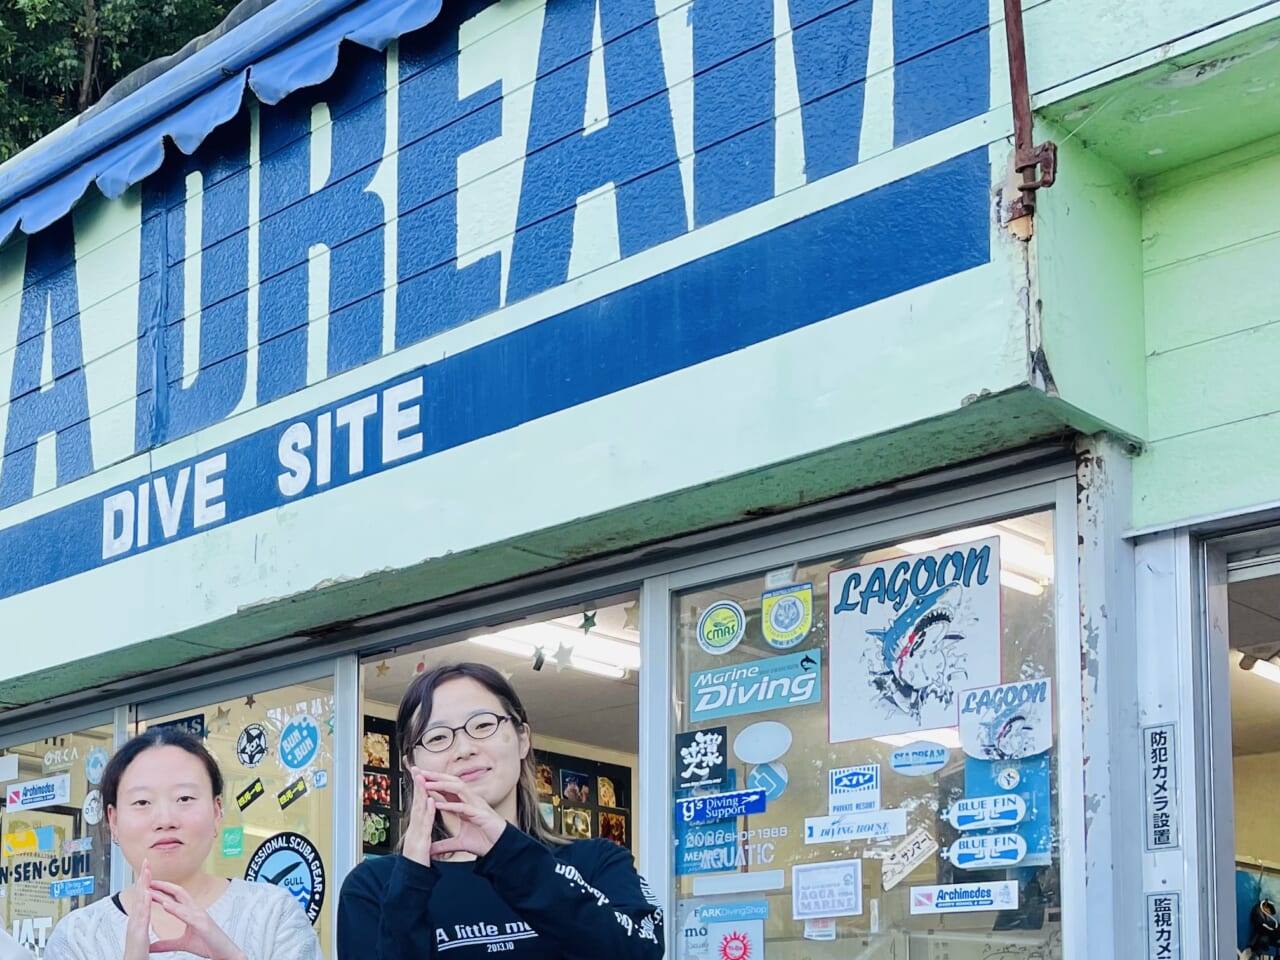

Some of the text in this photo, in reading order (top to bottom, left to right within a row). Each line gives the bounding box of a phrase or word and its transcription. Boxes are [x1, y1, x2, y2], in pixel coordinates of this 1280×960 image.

[102, 376, 424, 560] DIVE SITE
[834, 545, 991, 613] LAGOON
[694, 666, 760, 688] Marine
[694, 673, 817, 713] Diving
[962, 681, 1047, 714] LAGOON
[1150, 730, 1171, 846] 防犯カメラ設置
[705, 806, 746, 818] Support
[706, 797, 739, 809] Diving
[958, 797, 1017, 812] BLUE FIN
[958, 836, 1018, 850] BLUE FIN
[289, 836, 314, 863] SCUBA
[311, 860, 322, 893] GEAR
[284, 876, 304, 887] GULL
[801, 889, 834, 900] AQUA
[937, 887, 992, 901] Archimedes
[435, 928, 450, 943] A
[455, 922, 499, 939] little
[487, 942, 514, 952] 2013.10
